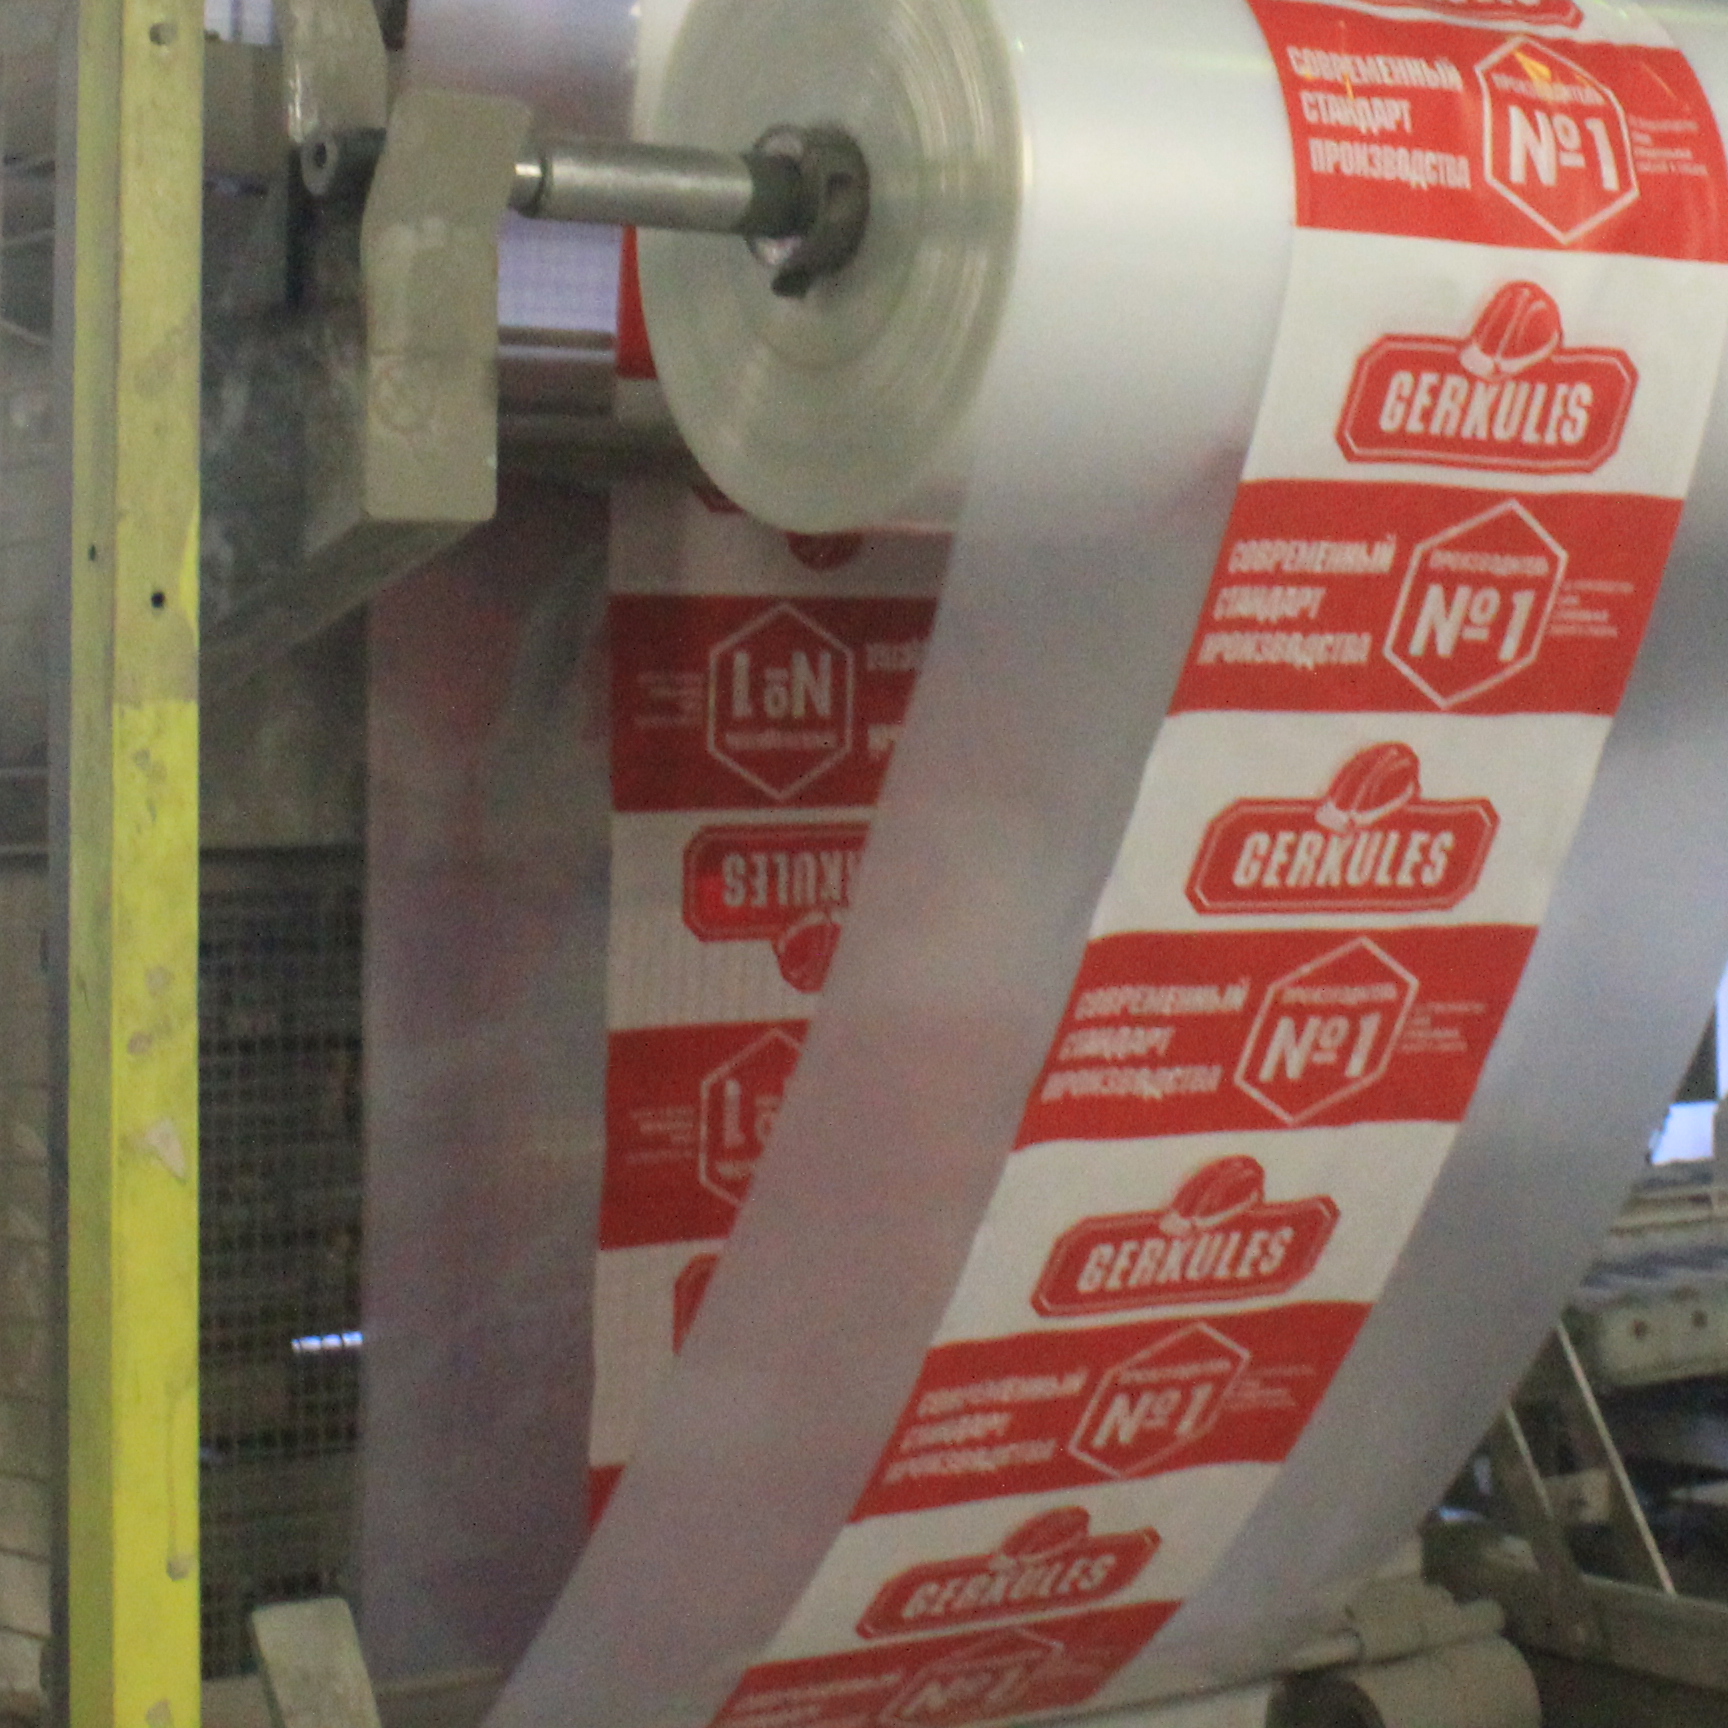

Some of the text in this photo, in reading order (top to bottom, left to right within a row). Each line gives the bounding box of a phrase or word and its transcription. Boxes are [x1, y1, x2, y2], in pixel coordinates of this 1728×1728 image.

[1287, 45, 1463, 92] СОВРЕМЕННЫЙ
[1300, 92, 1413, 135] СТАНДАРТ
[1309, 140, 1470, 190] ПРОИЗВОДСТВА
[1379, 371, 1592, 446] GERKULES
[723, 850, 862, 907] KULES
[1233, 831, 1455, 886] GERKULES
[1078, 1227, 1294, 1292] GERKULES
